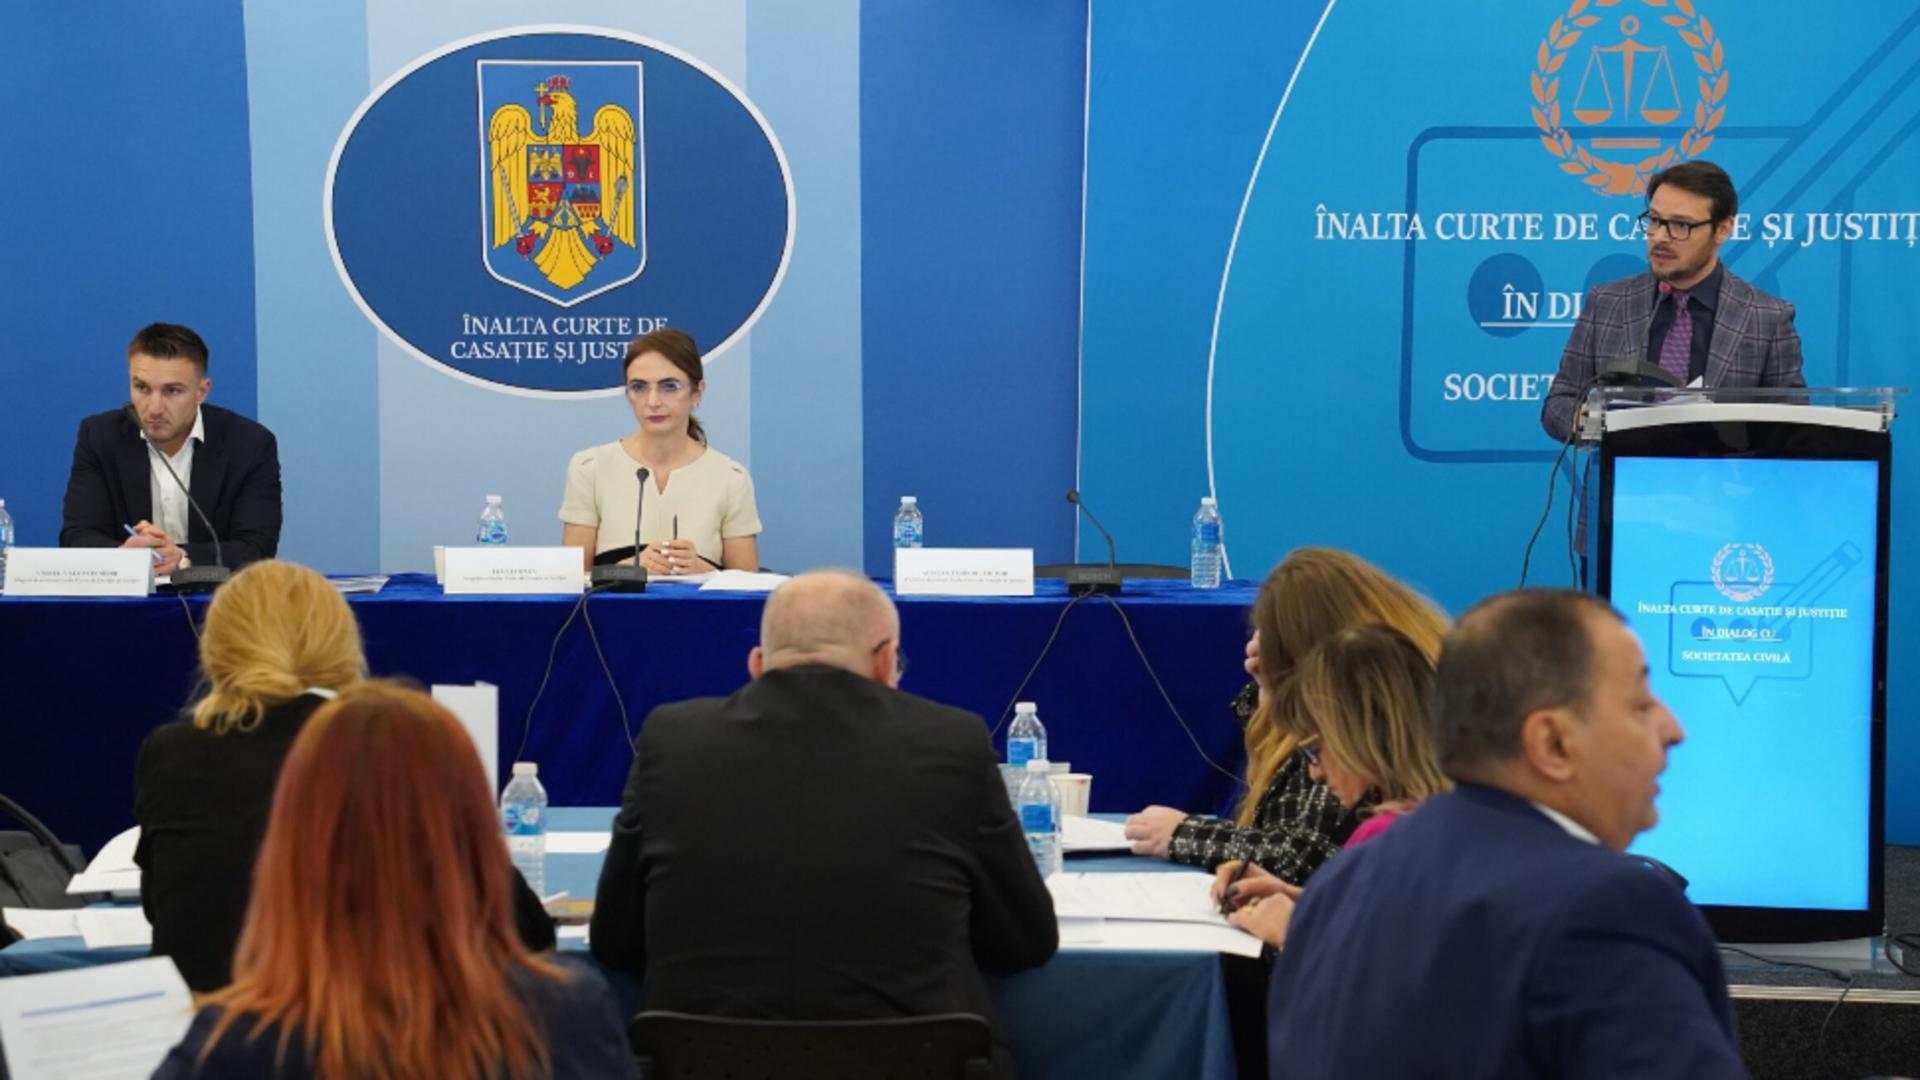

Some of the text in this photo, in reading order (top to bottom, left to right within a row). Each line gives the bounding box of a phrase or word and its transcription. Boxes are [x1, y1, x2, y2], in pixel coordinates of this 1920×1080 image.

[1315, 203, 1427, 240] ÎNALTA
[1434, 212, 1544, 240] CURTE
[1553, 212, 1599, 240] DE
[1761, 212, 1795, 248] ȘI
[1502, 283, 1539, 320] ÎN
[462, 314, 549, 335] ÎNALTA
[552, 316, 632, 335] CURTE
[450, 342, 633, 364] CASAȚIE ȘI JUST
[1444, 373, 1556, 401] SOCIET
